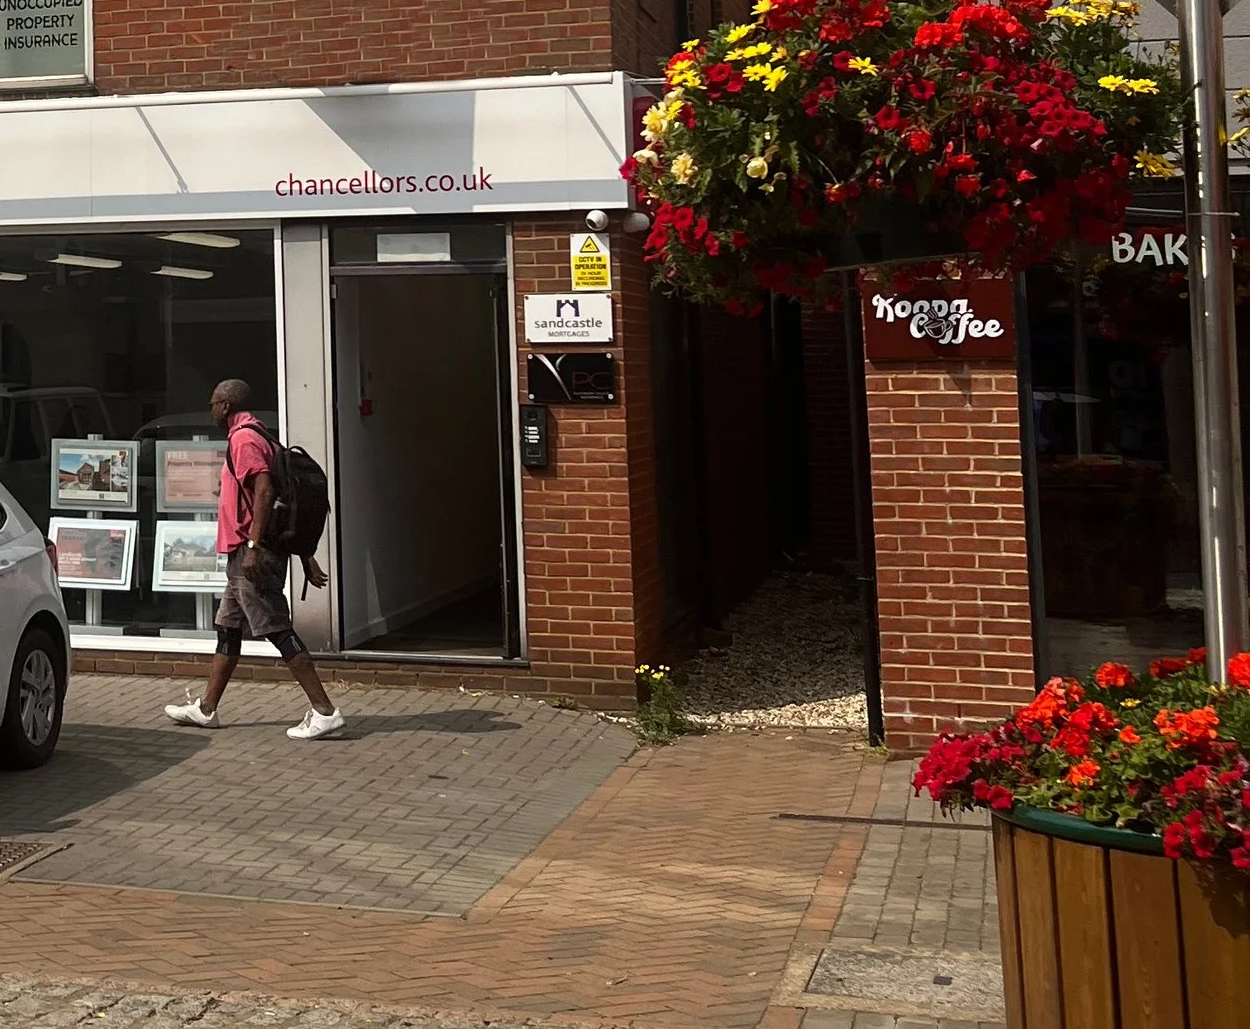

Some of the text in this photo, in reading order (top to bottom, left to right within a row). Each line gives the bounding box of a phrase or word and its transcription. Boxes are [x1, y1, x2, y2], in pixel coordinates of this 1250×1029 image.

[6, 14, 75, 31] PROPERTY
[4, 33, 78, 50] INSURANCE
[275, 166, 494, 197] chancellors.co.uk
[534, 317, 603, 329] sandcastle
[547, 330, 590, 338] MORTGAGES
